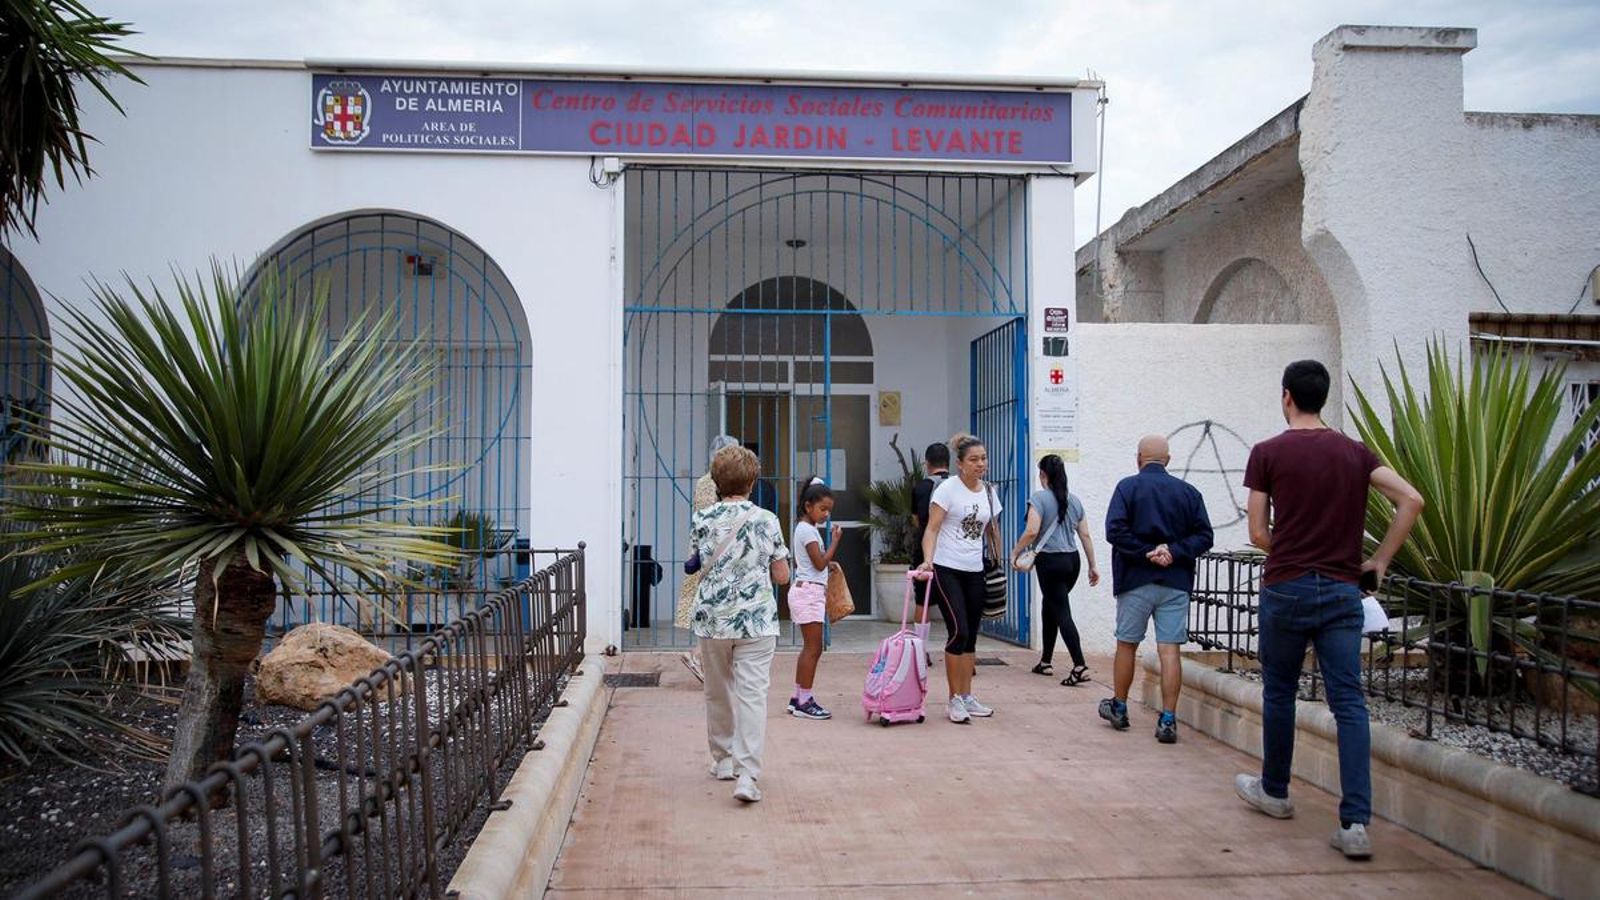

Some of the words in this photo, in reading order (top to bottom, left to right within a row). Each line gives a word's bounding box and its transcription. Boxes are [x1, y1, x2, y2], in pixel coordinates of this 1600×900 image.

[380, 79, 518, 96] AYUNTAMIENTO
[395, 97, 419, 111] DE
[425, 98, 504, 113] ALMERIA
[533, 87, 617, 112] Centro
[626, 89, 654, 112] de
[663, 89, 775, 115] Servicios
[783, 94, 884, 117] Sociales
[894, 96, 1055, 122] Comunitarios
[421, 121, 455, 132] AREA
[459, 122, 477, 133] DE
[381, 133, 450, 145] POLITICAS
[453, 134, 516, 146] SOCIALES
[590, 121, 716, 148] CIUDAD
[733, 123, 848, 151] JARDIN
[892, 127, 1024, 155] LEVANTE
